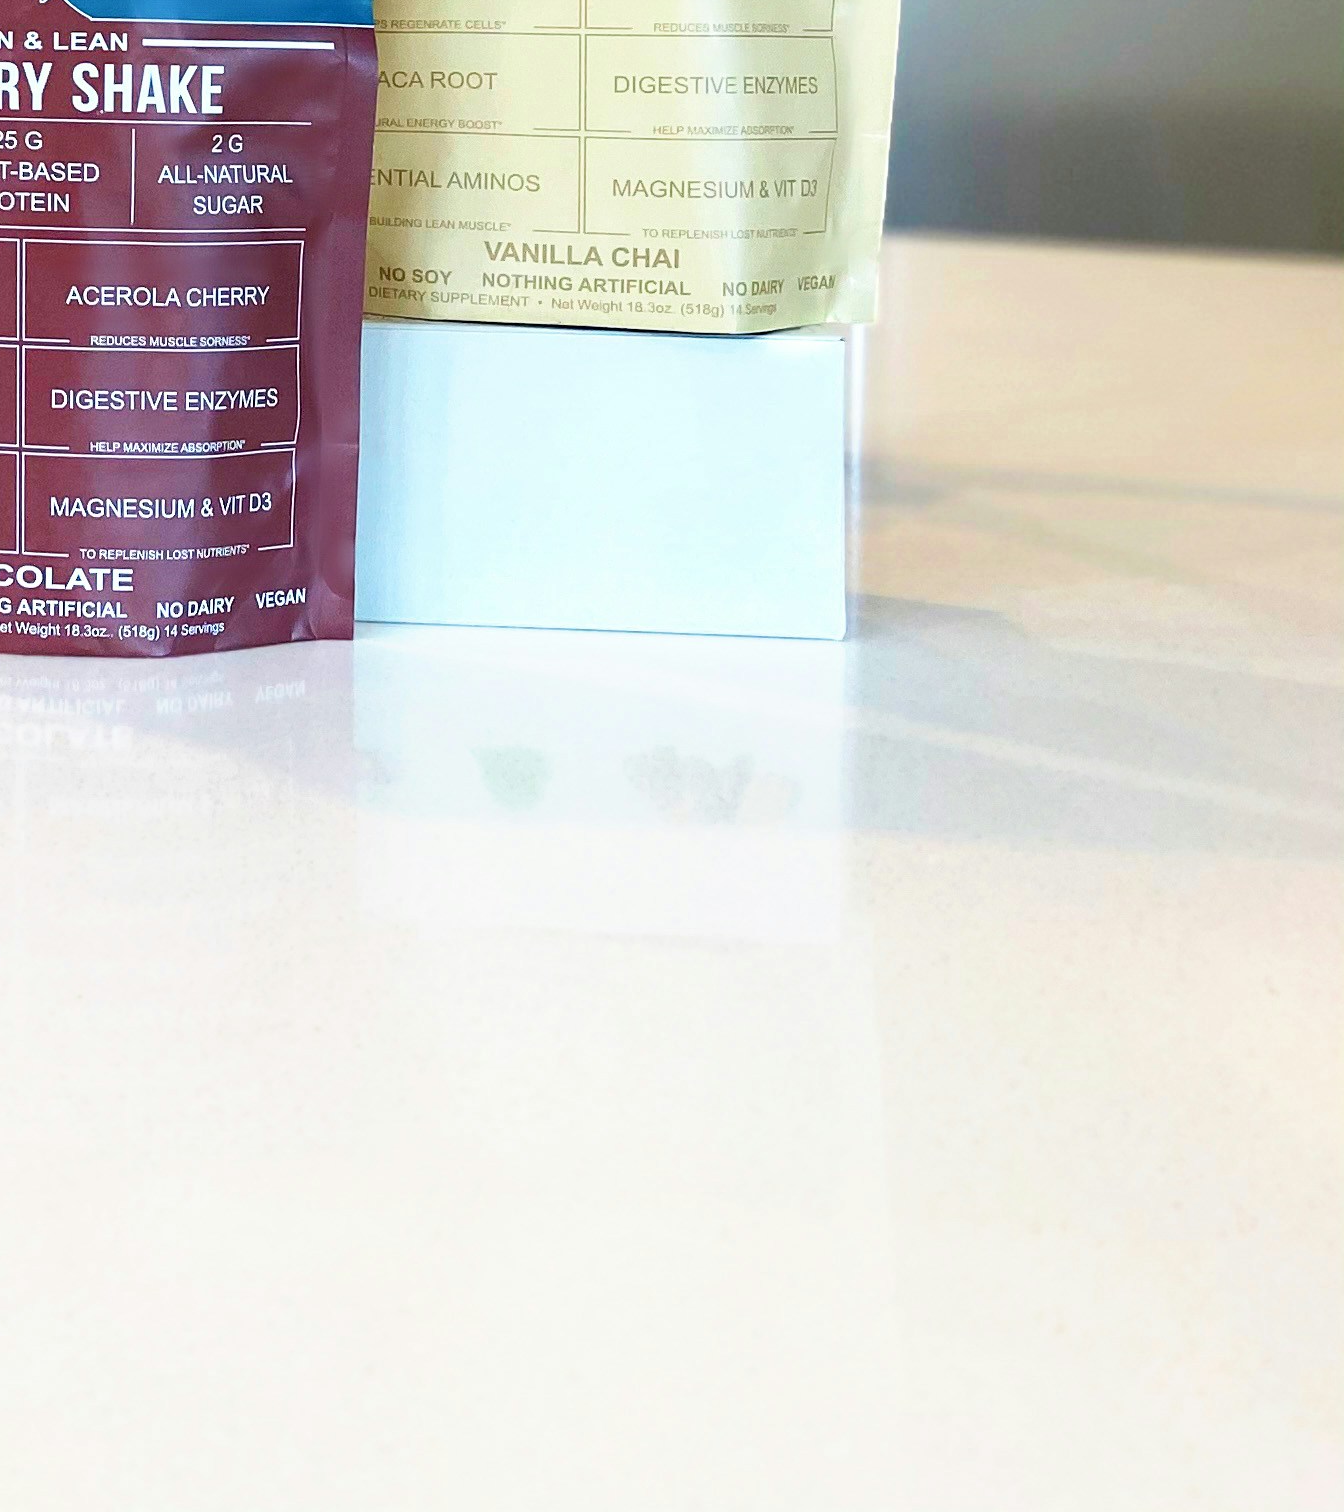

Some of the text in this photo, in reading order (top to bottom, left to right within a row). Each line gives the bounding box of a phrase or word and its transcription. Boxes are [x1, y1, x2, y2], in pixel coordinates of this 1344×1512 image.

[24, 32, 42, 49] &
[54, 32, 127, 51] LEAN
[72, 63, 224, 114] SHAKE
[431, 72, 497, 89] ROOT
[615, 76, 817, 94] DIGESTIVE ENZYMES
[25, 131, 42, 150] G
[212, 135, 242, 152] 2 G
[158, 165, 293, 183] ALL-NATURAL
[447, 172, 540, 192] AMINOS
[613, 179, 817, 198] MAGNESIUM VIT D3
[194, 196, 263, 214] SUGAR
[484, 241, 679, 268] VANILLA CHAI
[412, 269, 452, 285] SOY
[483, 273, 691, 295] NOTHING ARTIFICIAL
[66, 286, 269, 307] ACEROLA CHERRY
[752, 280, 784, 296] DAIRY
[90, 335, 198, 347] REDUCES MUSCLE
[52, 388, 277, 410] DIGESTIVE ENZYMES
[90, 442, 178, 452] HELP MAXIMIZE
[51, 492, 271, 518] MAGNESIUM & VIT D3
[99, 549, 163, 560] REPLENISH
[157, 596, 234, 618] NO DAIRY
[256, 588, 306, 608] VEGAN
[17, 599, 127, 618] ARTIFICIAL
[15, 621, 60, 638] Weight
[119, 625, 159, 641] (518g)
[181, 623, 224, 636] Servings
